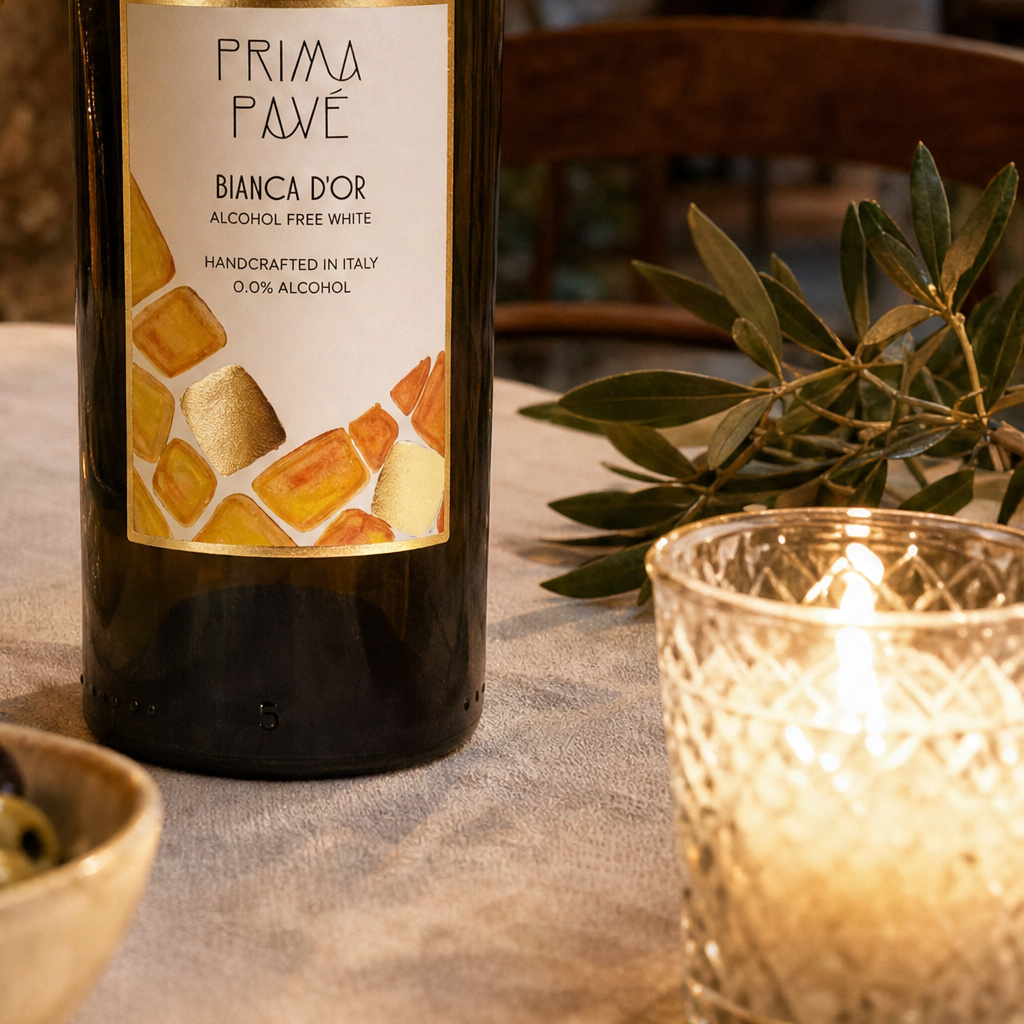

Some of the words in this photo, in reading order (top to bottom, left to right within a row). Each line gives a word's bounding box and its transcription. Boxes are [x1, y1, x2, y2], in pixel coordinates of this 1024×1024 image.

[218, 38, 361, 82] PRIMA
[233, 88, 348, 139] PAVÉ
[216, 174, 299, 200] BIANCA
[311, 175, 365, 200] D'OR
[210, 211, 281, 225] ALCOHOL
[287, 213, 323, 225] FREE
[328, 212, 371, 225] WHITE
[205, 256, 318, 270] HANDCRAFTED
[324, 259, 337, 270] IN
[343, 257, 378, 270] ITALY
[233, 280, 273, 294] 0.0%
[278, 281, 351, 294] ALCOHOL
[259, 701, 278, 731] 5
